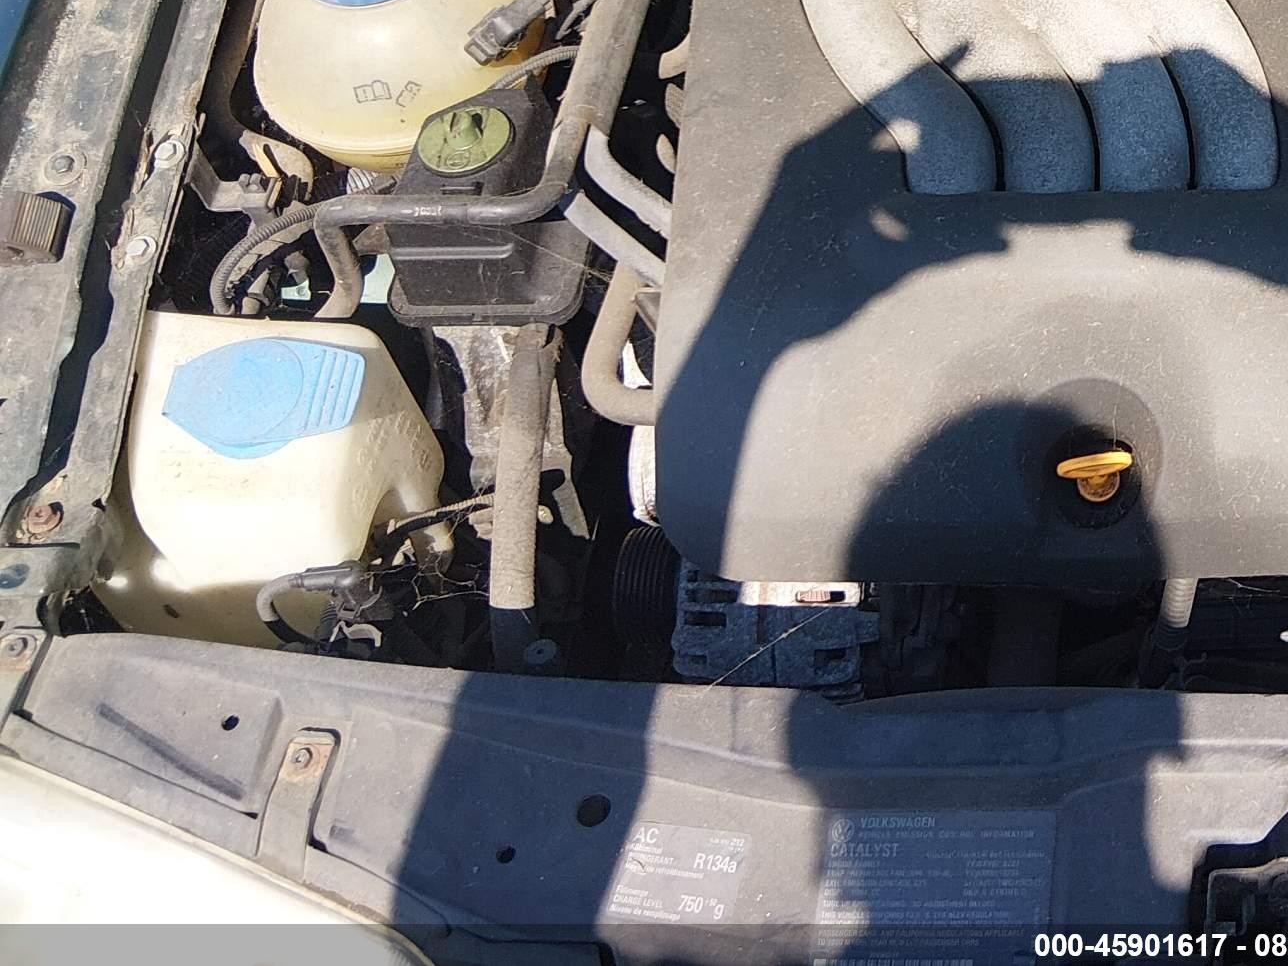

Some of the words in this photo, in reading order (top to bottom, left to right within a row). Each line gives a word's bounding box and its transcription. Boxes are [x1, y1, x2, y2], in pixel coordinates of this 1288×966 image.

[860, 817, 936, 829] VOLKSWAGEN
[634, 827, 660, 844] AC
[830, 843, 900, 857] CATALYST
[694, 853, 738, 873] R134a
[678, 894, 704, 914] 750
